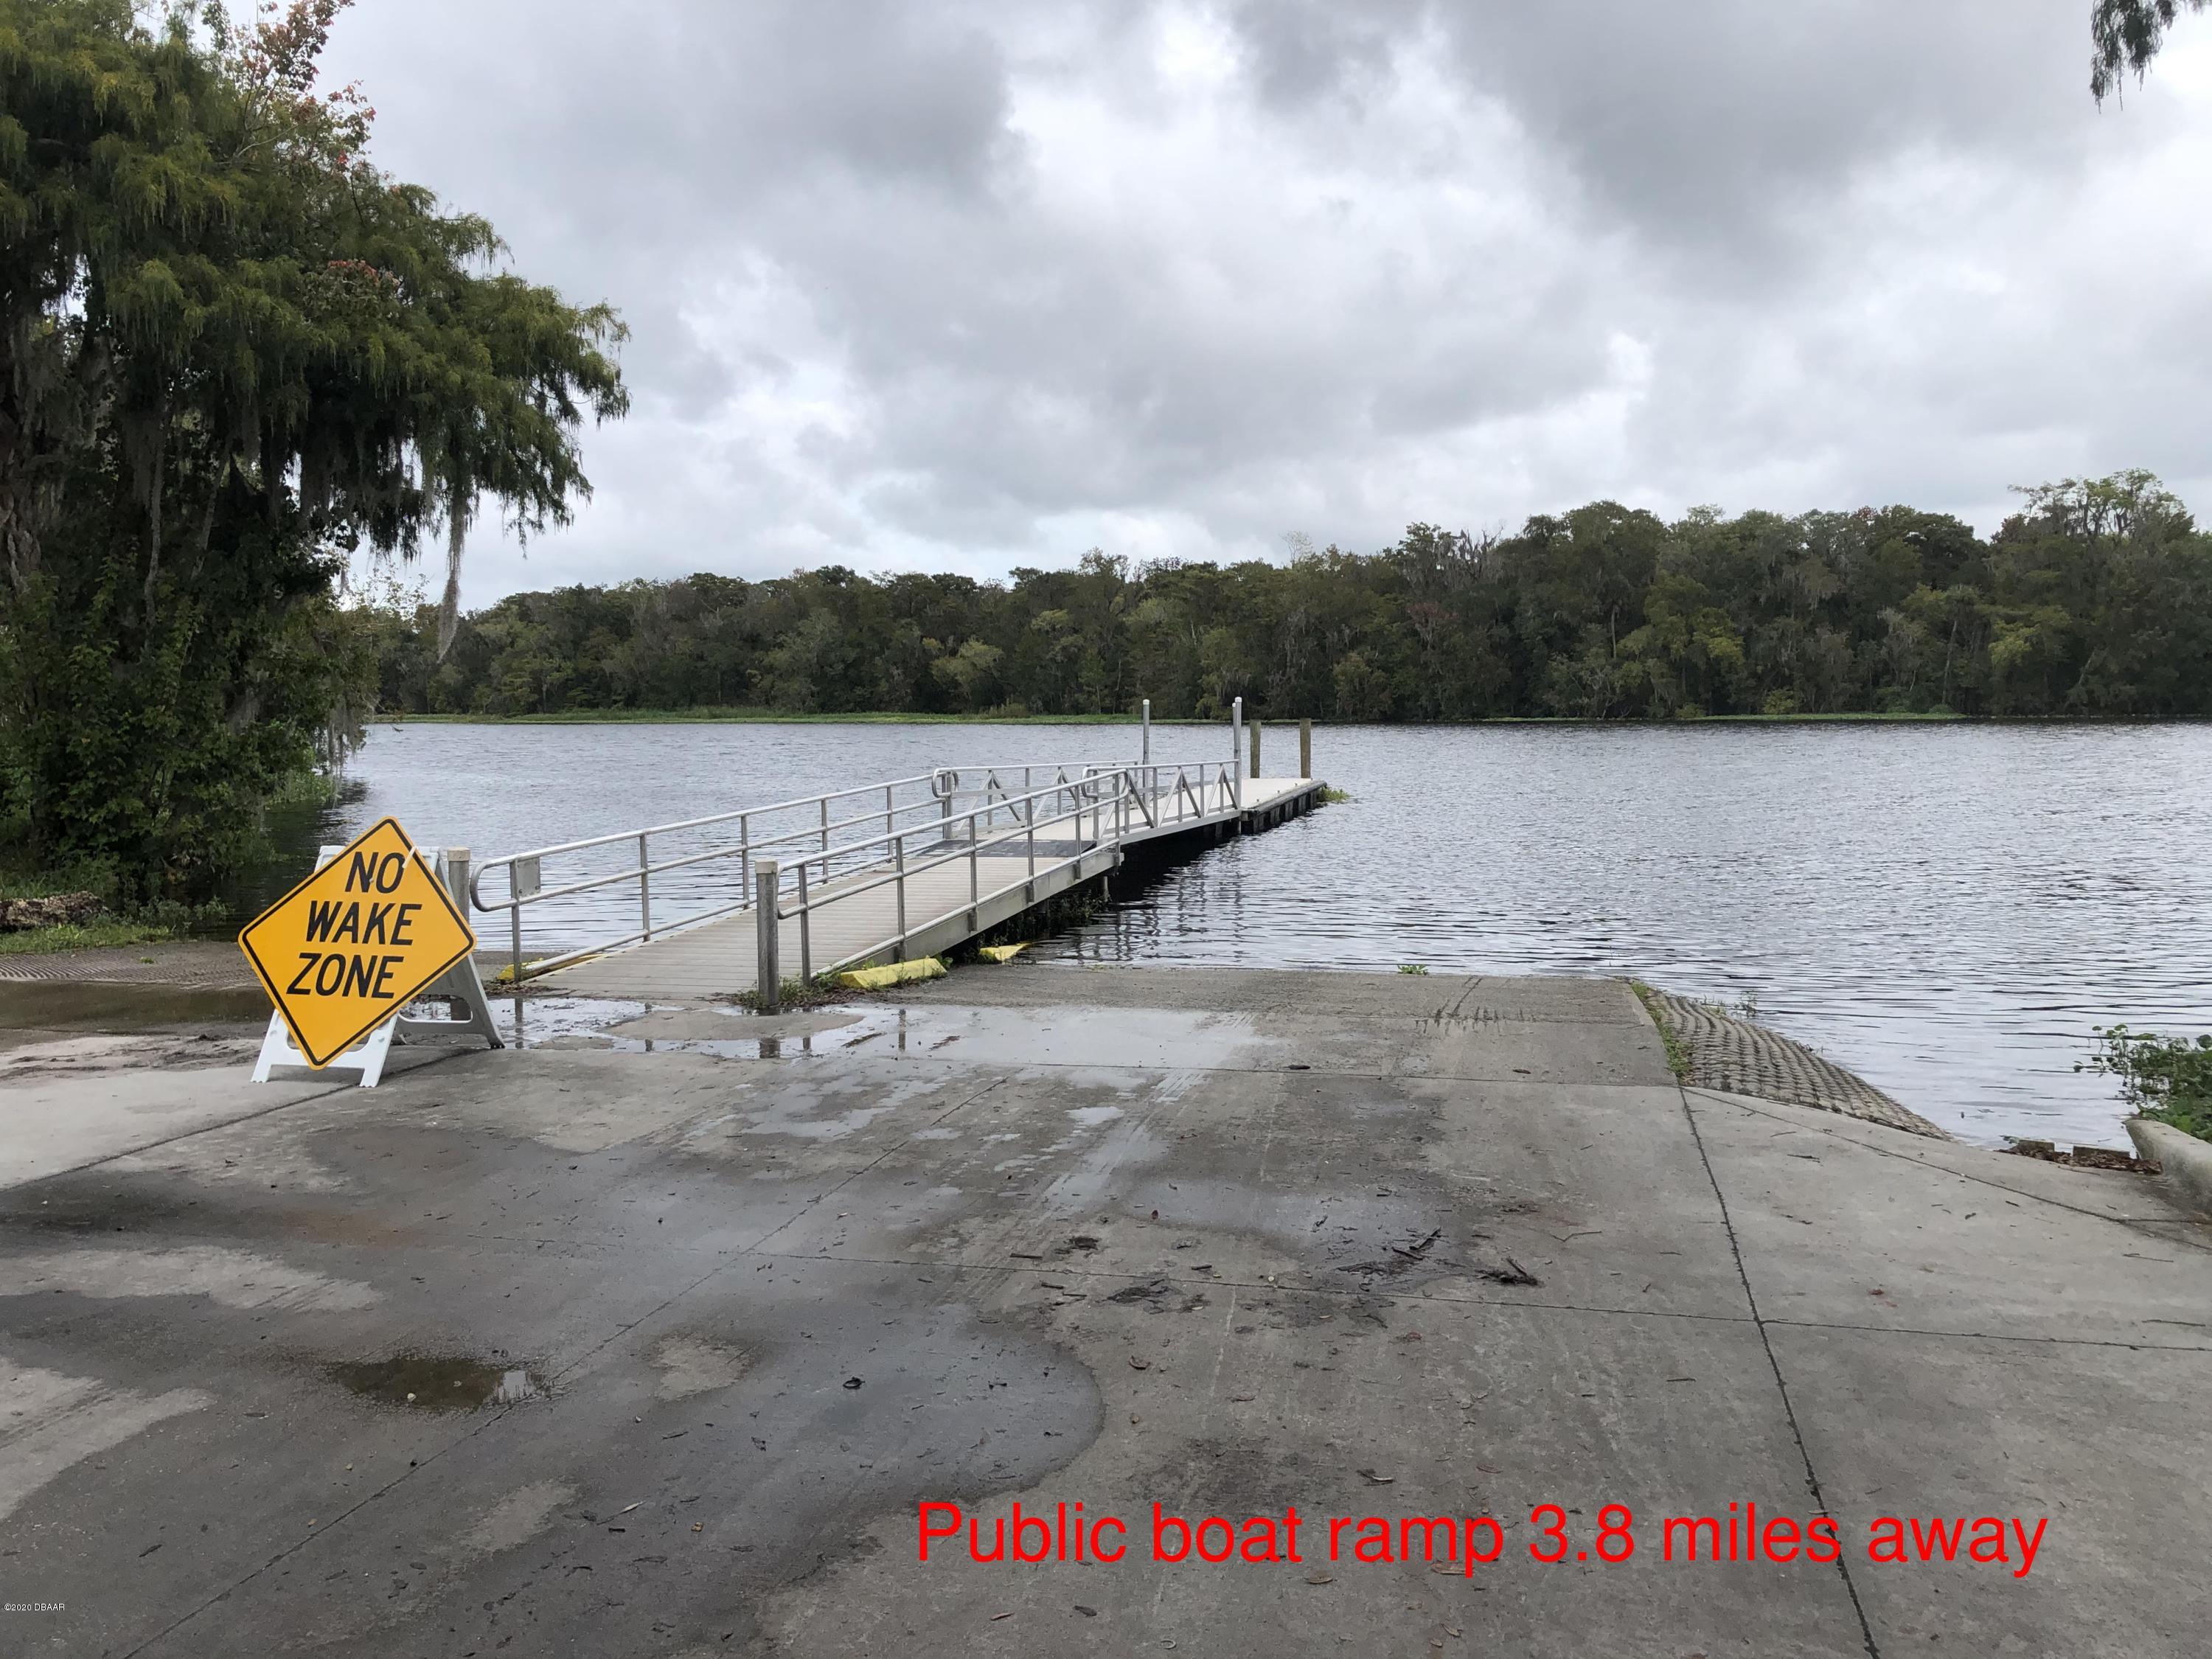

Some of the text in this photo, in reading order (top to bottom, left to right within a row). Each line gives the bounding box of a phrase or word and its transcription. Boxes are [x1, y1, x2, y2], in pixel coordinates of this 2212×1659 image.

[344, 851, 406, 894] NO
[305, 900, 422, 945] WAKE
[286, 952, 405, 999] ZONE
